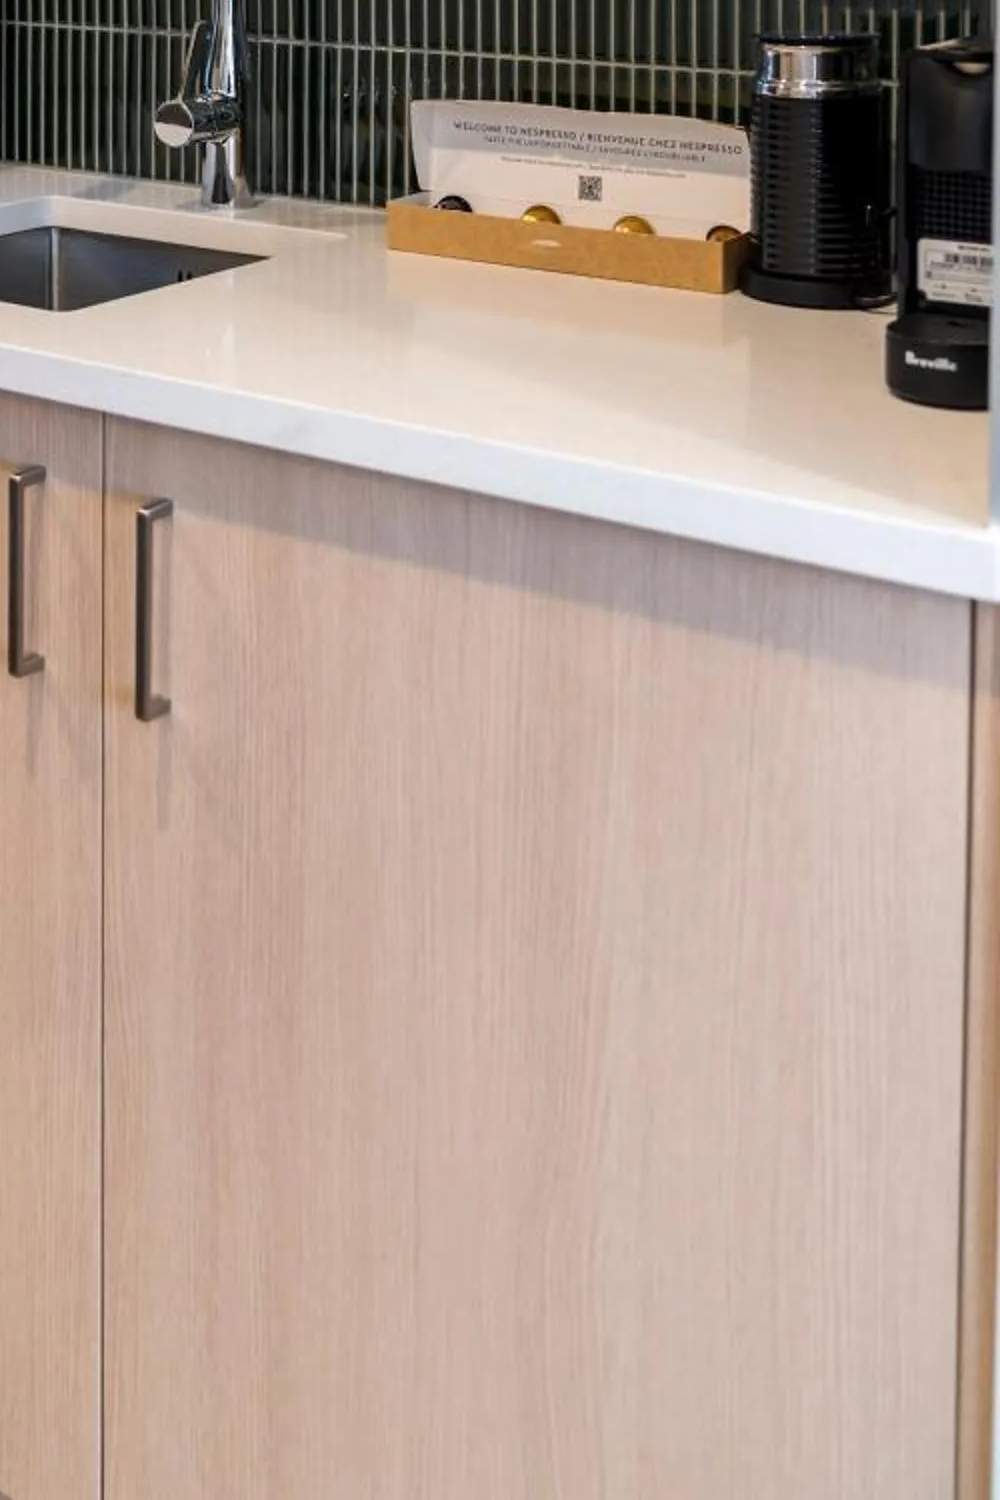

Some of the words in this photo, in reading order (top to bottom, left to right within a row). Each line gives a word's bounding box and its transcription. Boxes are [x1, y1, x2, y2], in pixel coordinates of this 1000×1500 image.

[453, 119, 502, 133] WELCOME
[504, 125, 518, 135] TO
[519, 126, 577, 141] NESPRESSO
[647, 137, 677, 149] CHEZ
[679, 140, 743, 155] NESPRESSO
